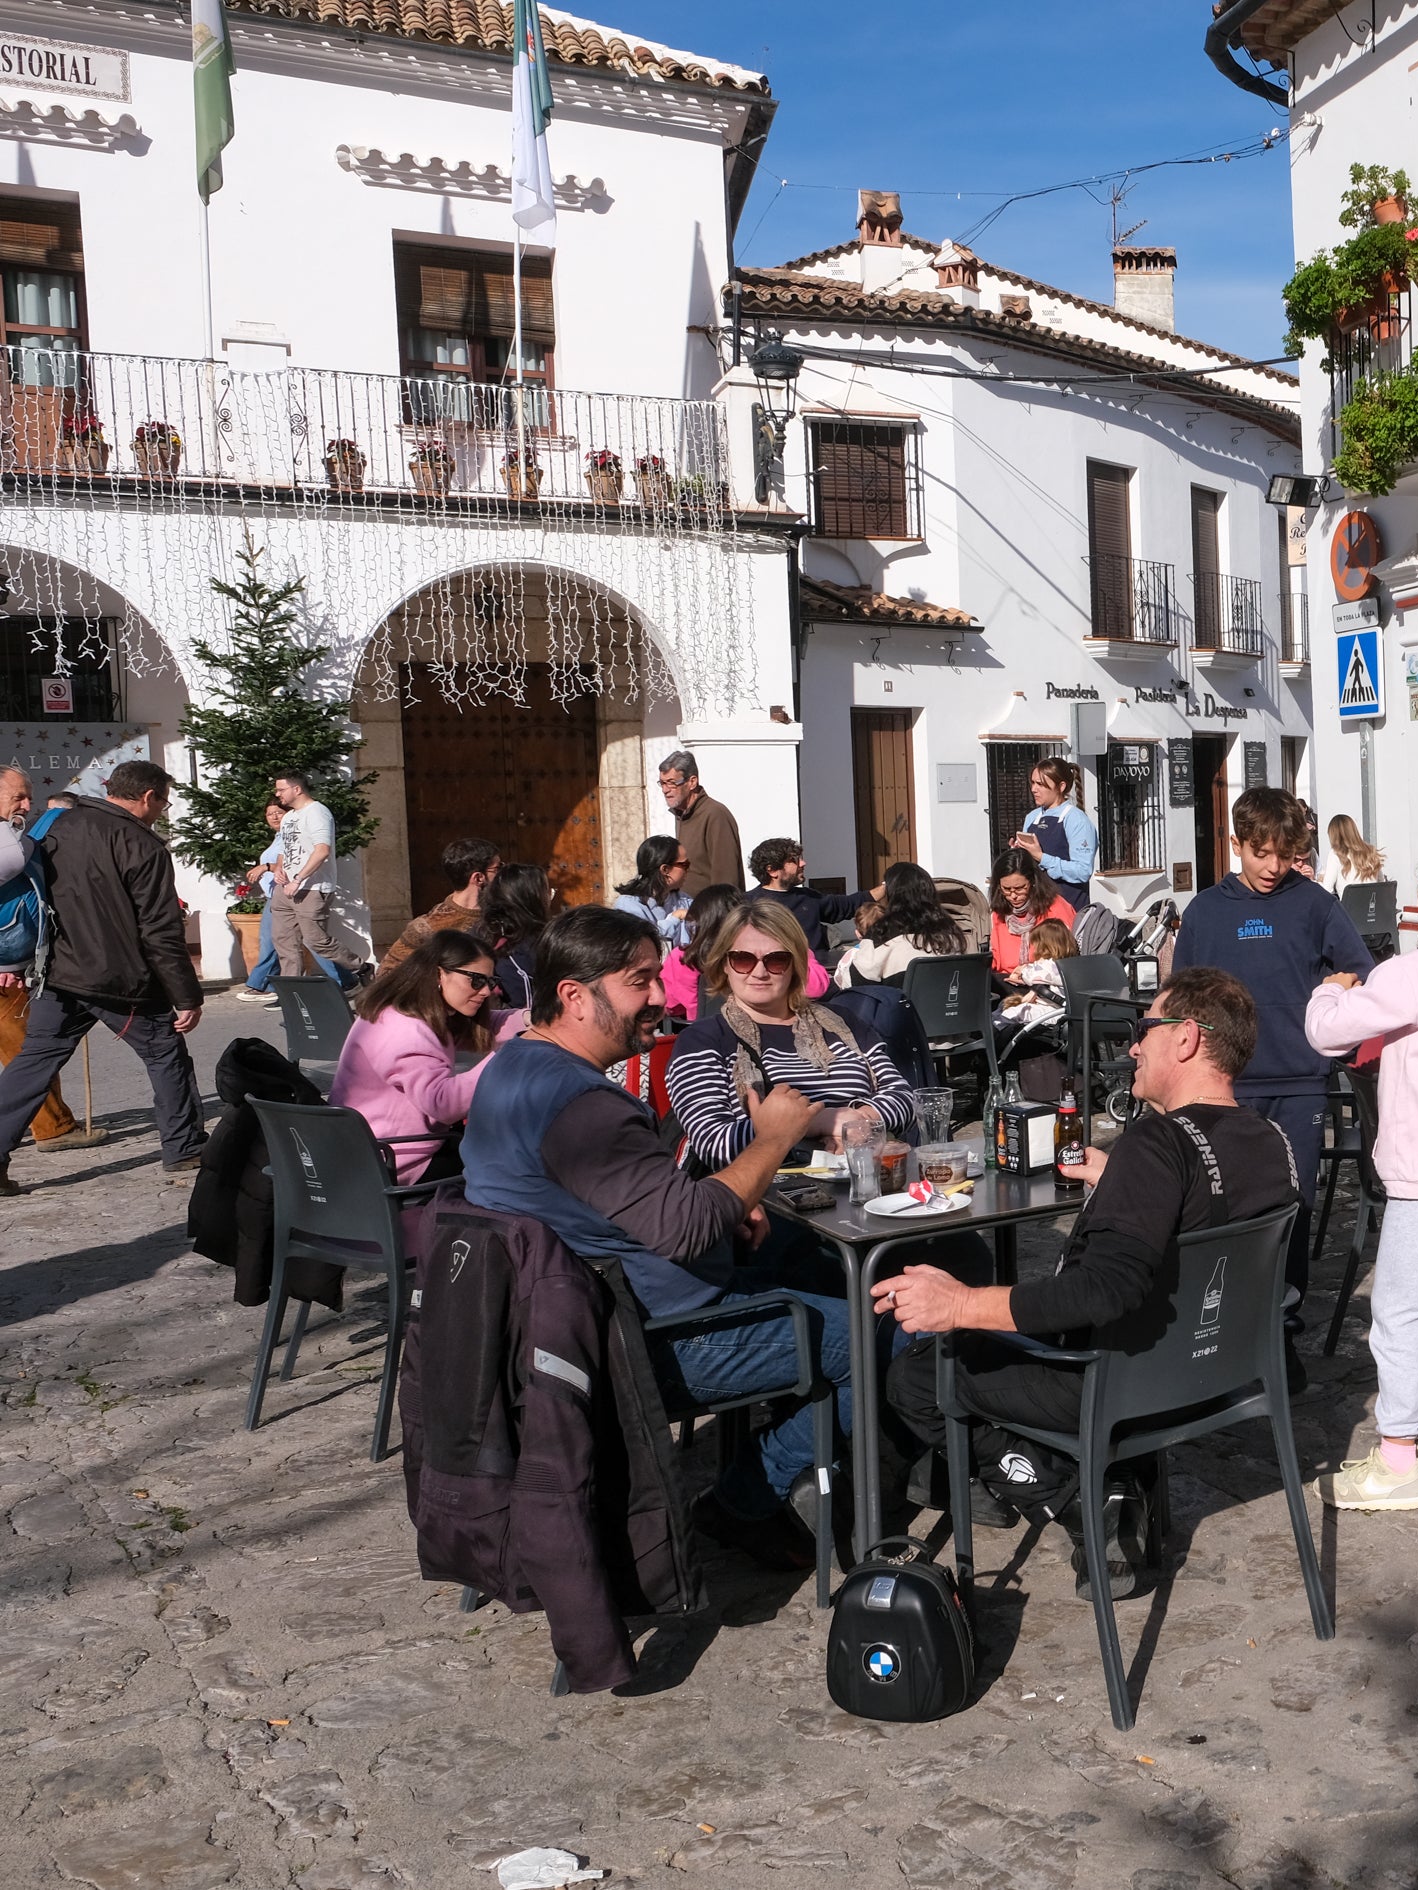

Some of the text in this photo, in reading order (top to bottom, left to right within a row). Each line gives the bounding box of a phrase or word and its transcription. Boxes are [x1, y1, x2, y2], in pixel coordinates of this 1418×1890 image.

[0, 44, 97, 86] STORIAL
[1184, 691, 1248, 728] La Despensa
[1237, 926, 1273, 937] SMITH
[1062, 1149, 1084, 1159] Estrell
[1062, 1157, 1084, 1166] Galici
[1172, 1116, 1224, 1195] RAINERS
